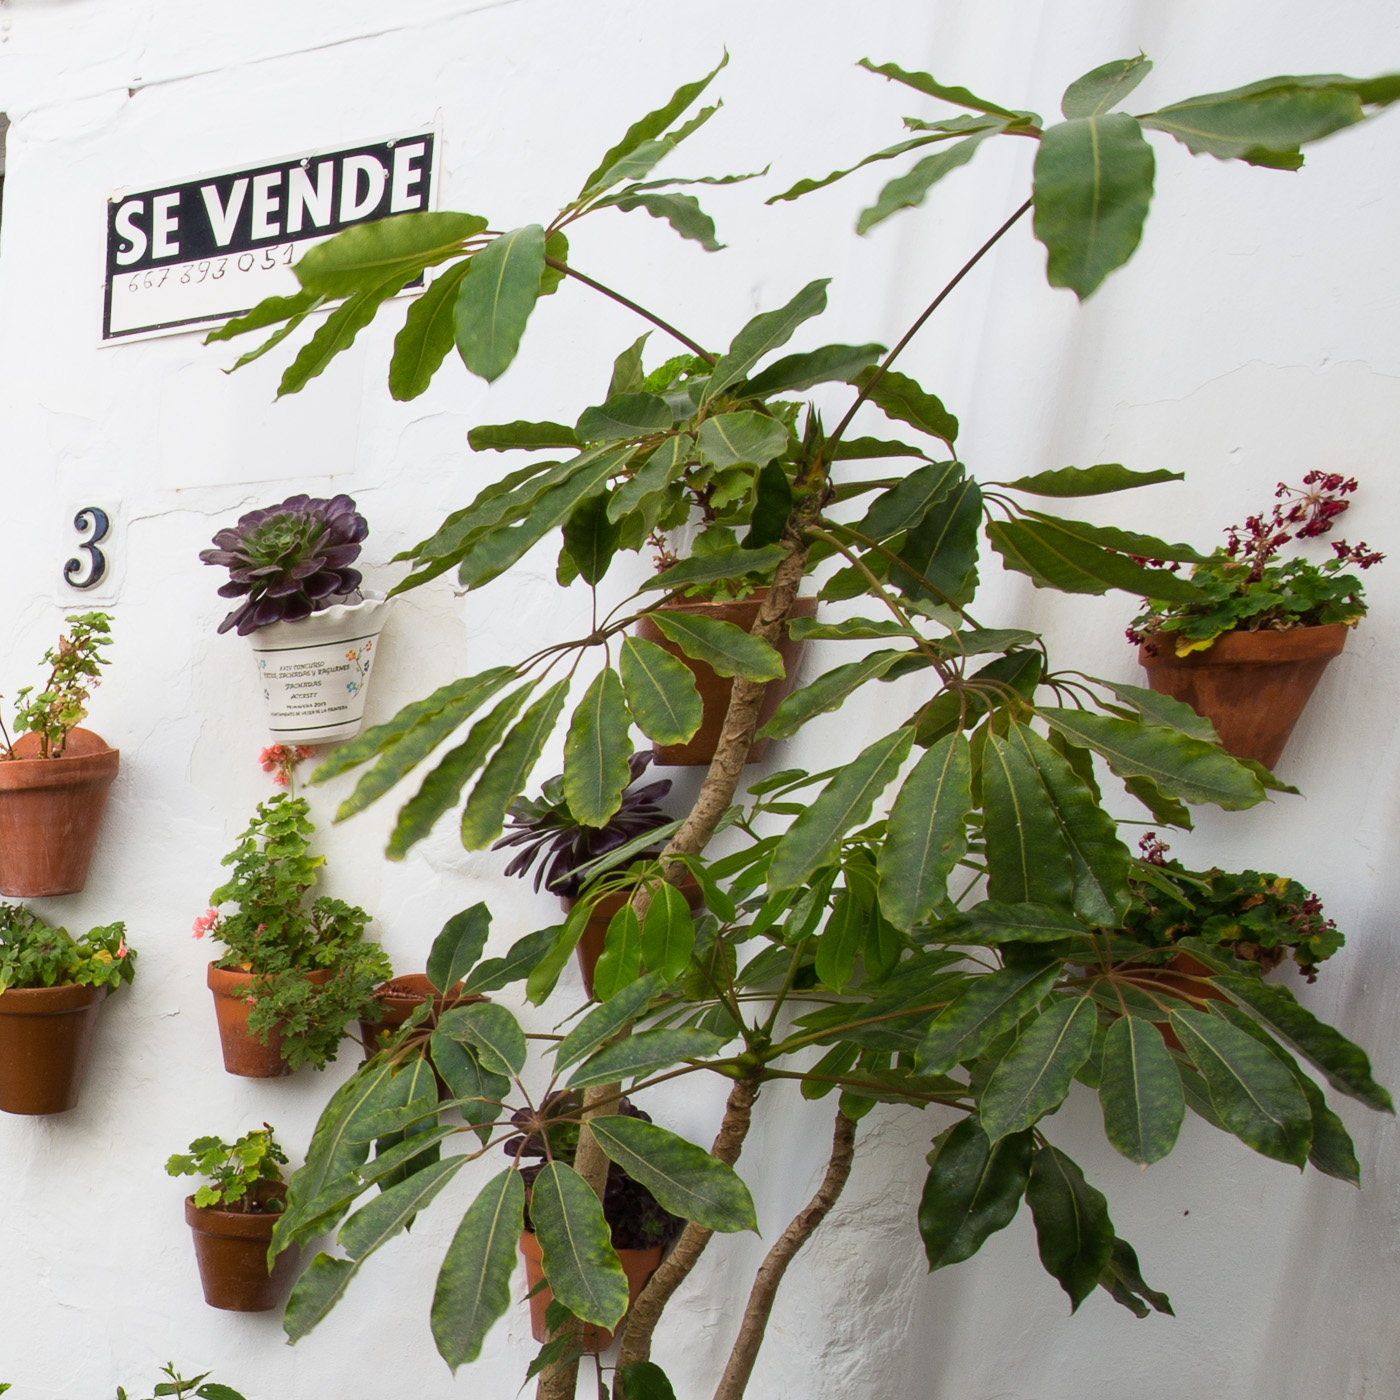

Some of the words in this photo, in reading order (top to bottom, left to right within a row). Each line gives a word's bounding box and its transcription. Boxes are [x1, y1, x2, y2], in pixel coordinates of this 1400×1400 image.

[114, 191, 181, 266] SE
[200, 142, 426, 248] VENDE
[128, 268, 170, 292] 667
[62, 506, 110, 590] 3
[293, 661, 325, 670] CONCURSO
